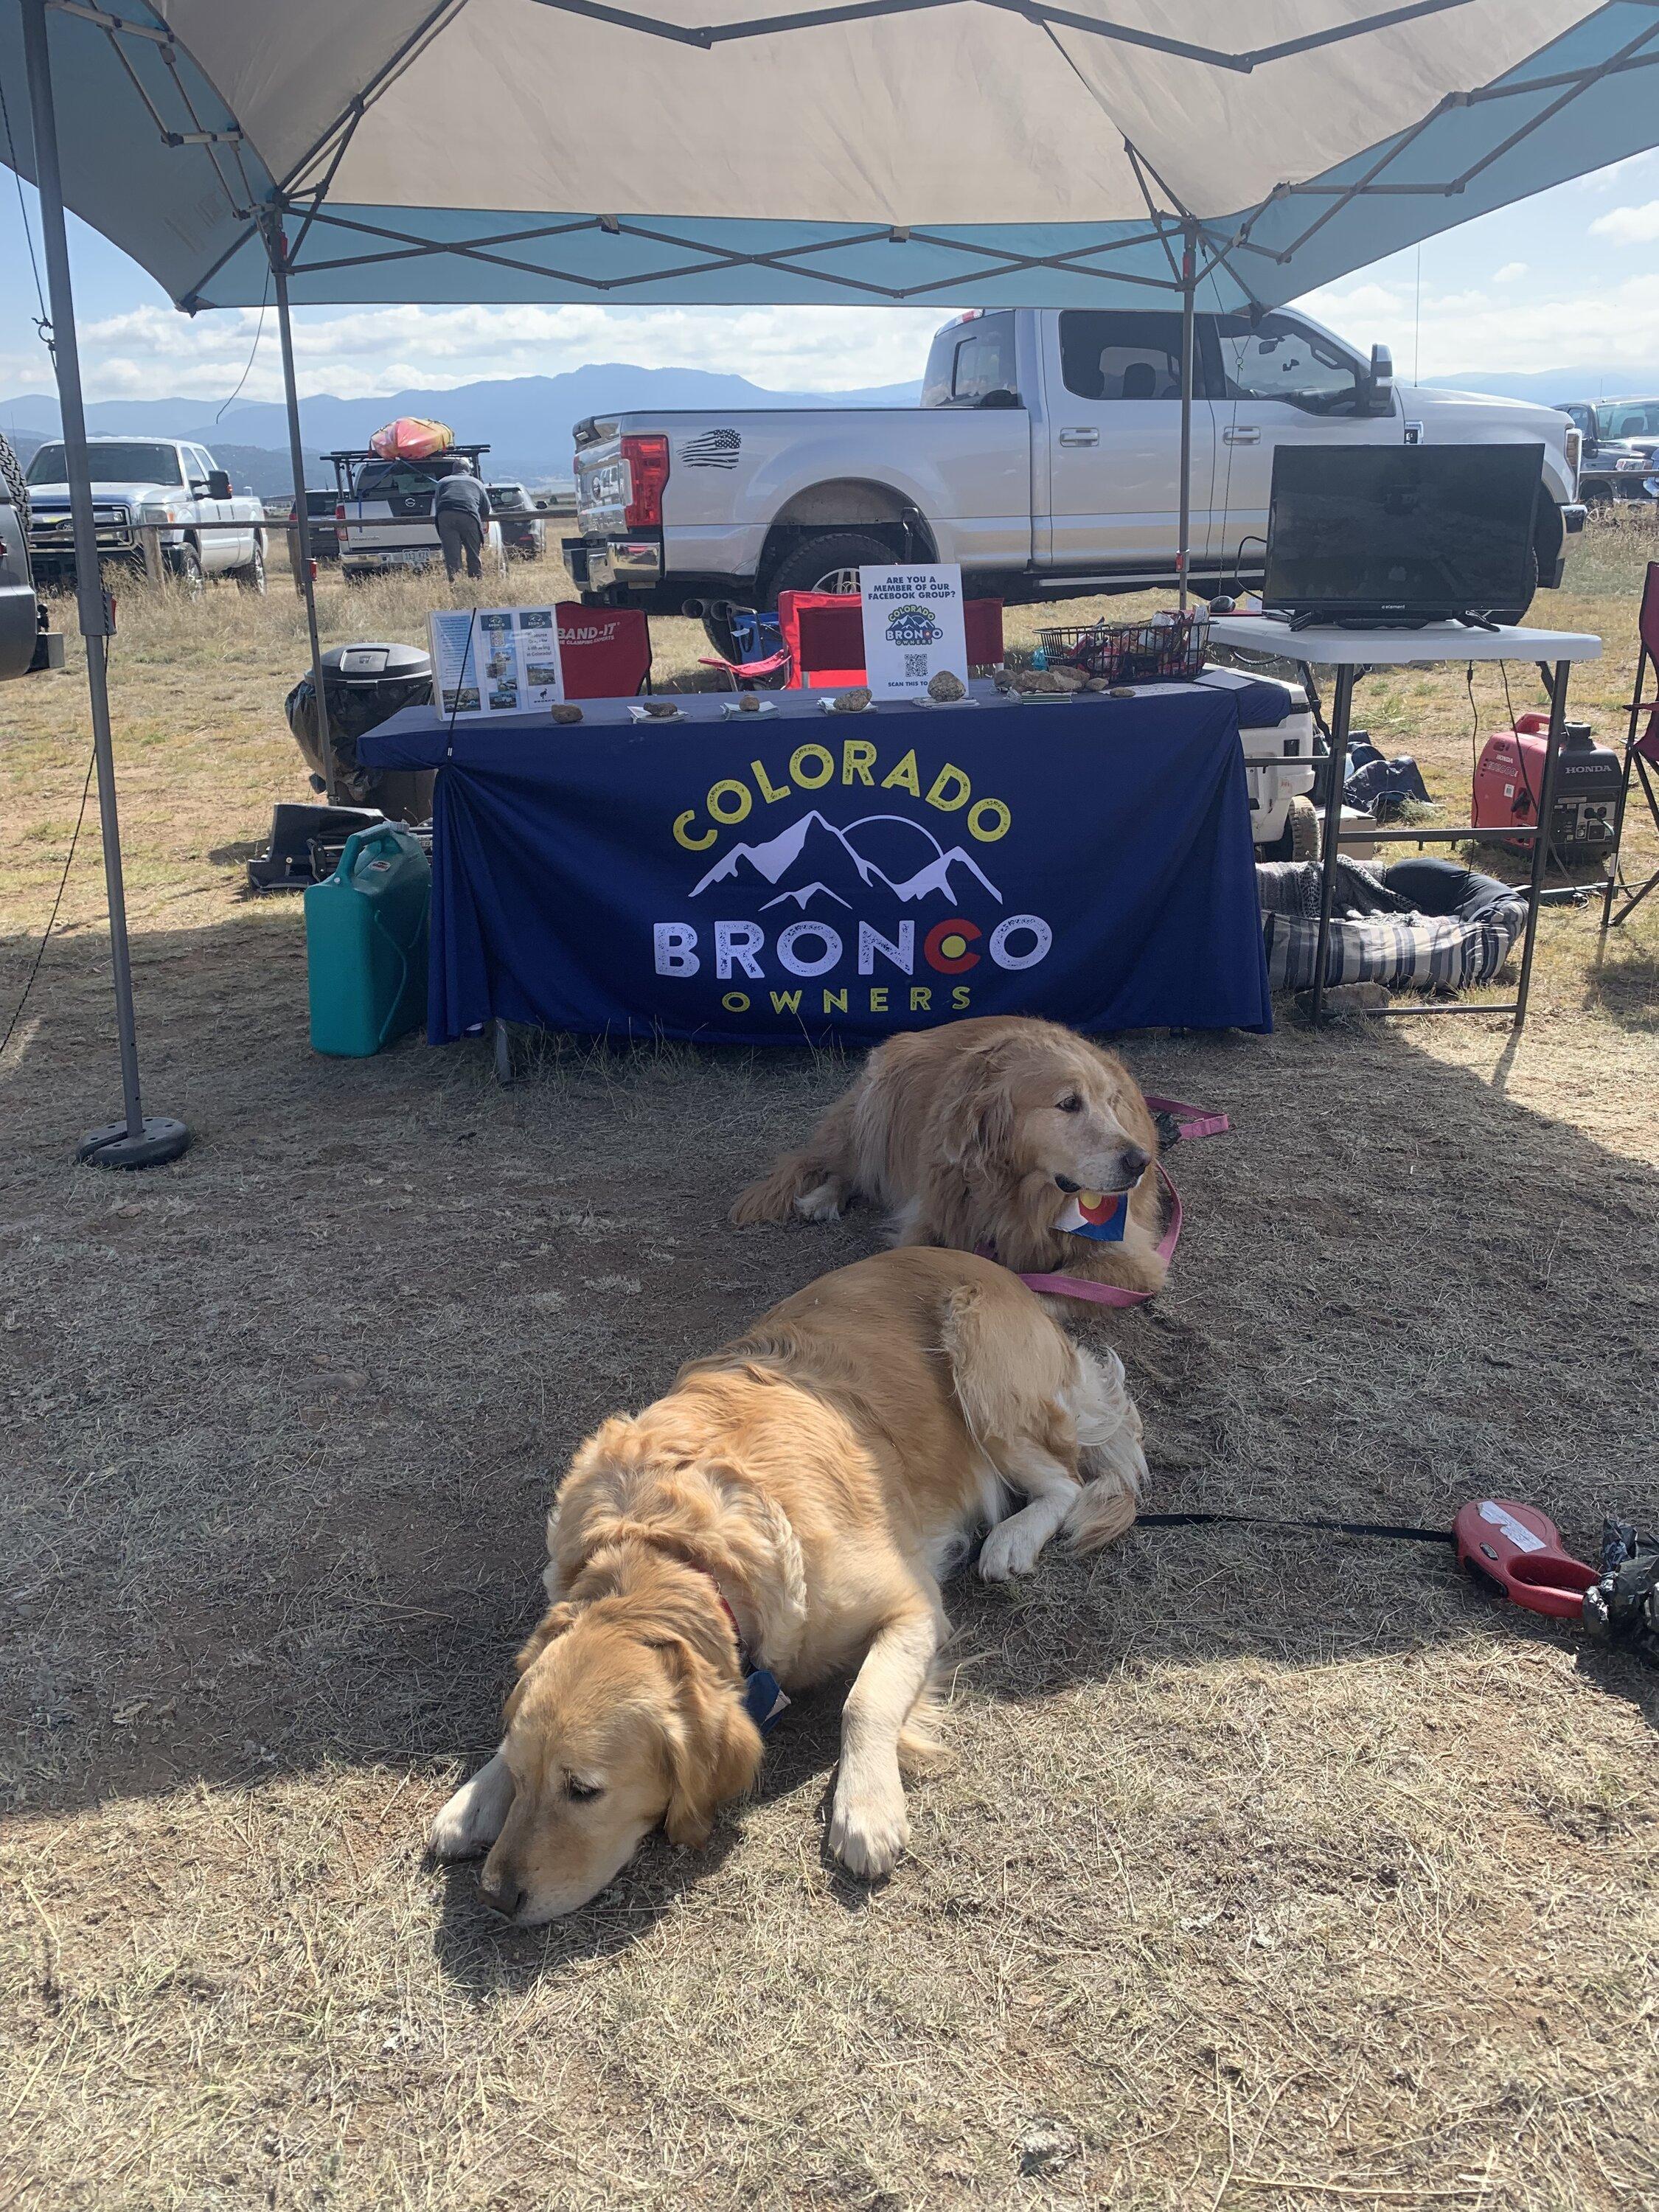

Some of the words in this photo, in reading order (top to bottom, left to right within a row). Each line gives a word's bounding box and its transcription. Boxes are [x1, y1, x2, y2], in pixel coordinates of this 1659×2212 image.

[868, 592, 915, 600] FACEBOOK
[918, 591, 956, 599] GROUP?
[888, 605, 936, 622] COLORADO
[593, 635, 615, 643] EXPERTS
[1565, 765, 1612, 774] HONDA
[672, 740, 1011, 851] COLORADO
[653, 914, 1053, 979] BRONCO
[722, 987, 970, 1014] OWNERS
